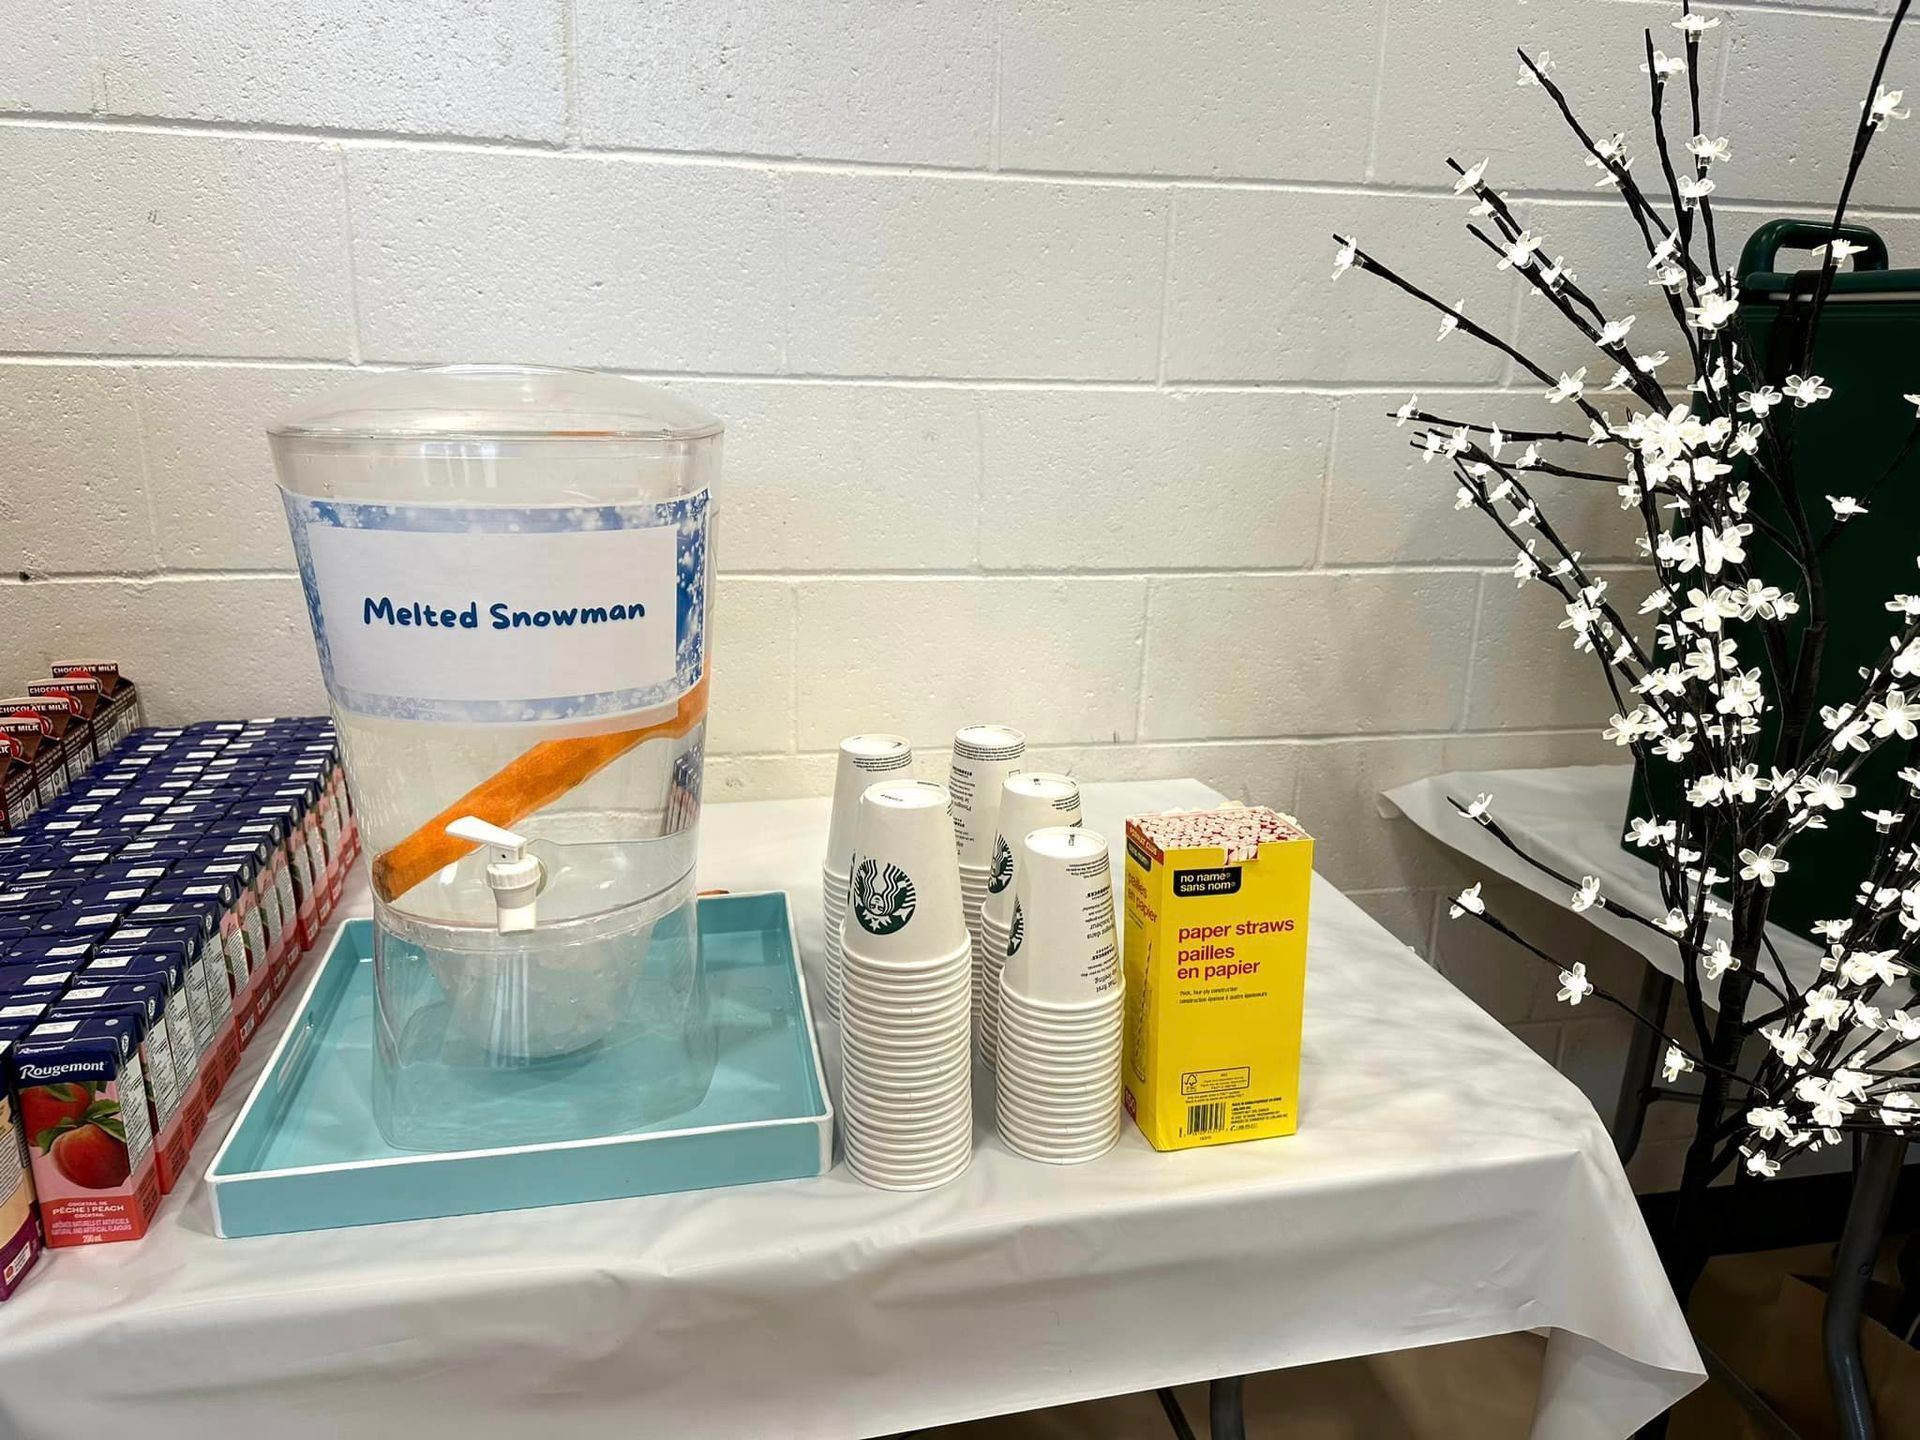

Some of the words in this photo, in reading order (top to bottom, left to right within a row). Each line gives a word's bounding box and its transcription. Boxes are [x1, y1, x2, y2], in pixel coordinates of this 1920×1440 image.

[363, 597, 478, 629] Melted
[489, 603, 646, 630] Snowman
[53, 665, 97, 674] CHOCOLATE
[98, 664, 117, 672] MILK
[29, 685, 75, 694] CHOCOLATE
[48, 702, 69, 710] MILK
[17, 723, 40, 731] MILK
[1180, 874, 1194, 883] no
[1180, 882, 1206, 892] sans
[1135, 896, 1158, 923] papier
[1178, 924, 1232, 943] paper
[1235, 919, 1295, 936] straws
[1177, 945, 1235, 965] pailles
[1177, 967, 1200, 980] en
[1204, 960, 1261, 981] papier
[20, 1061, 105, 1080] Rougemont
[52, 1206, 85, 1215] PÊCHE
[92, 1205, 124, 1213] PEACH
